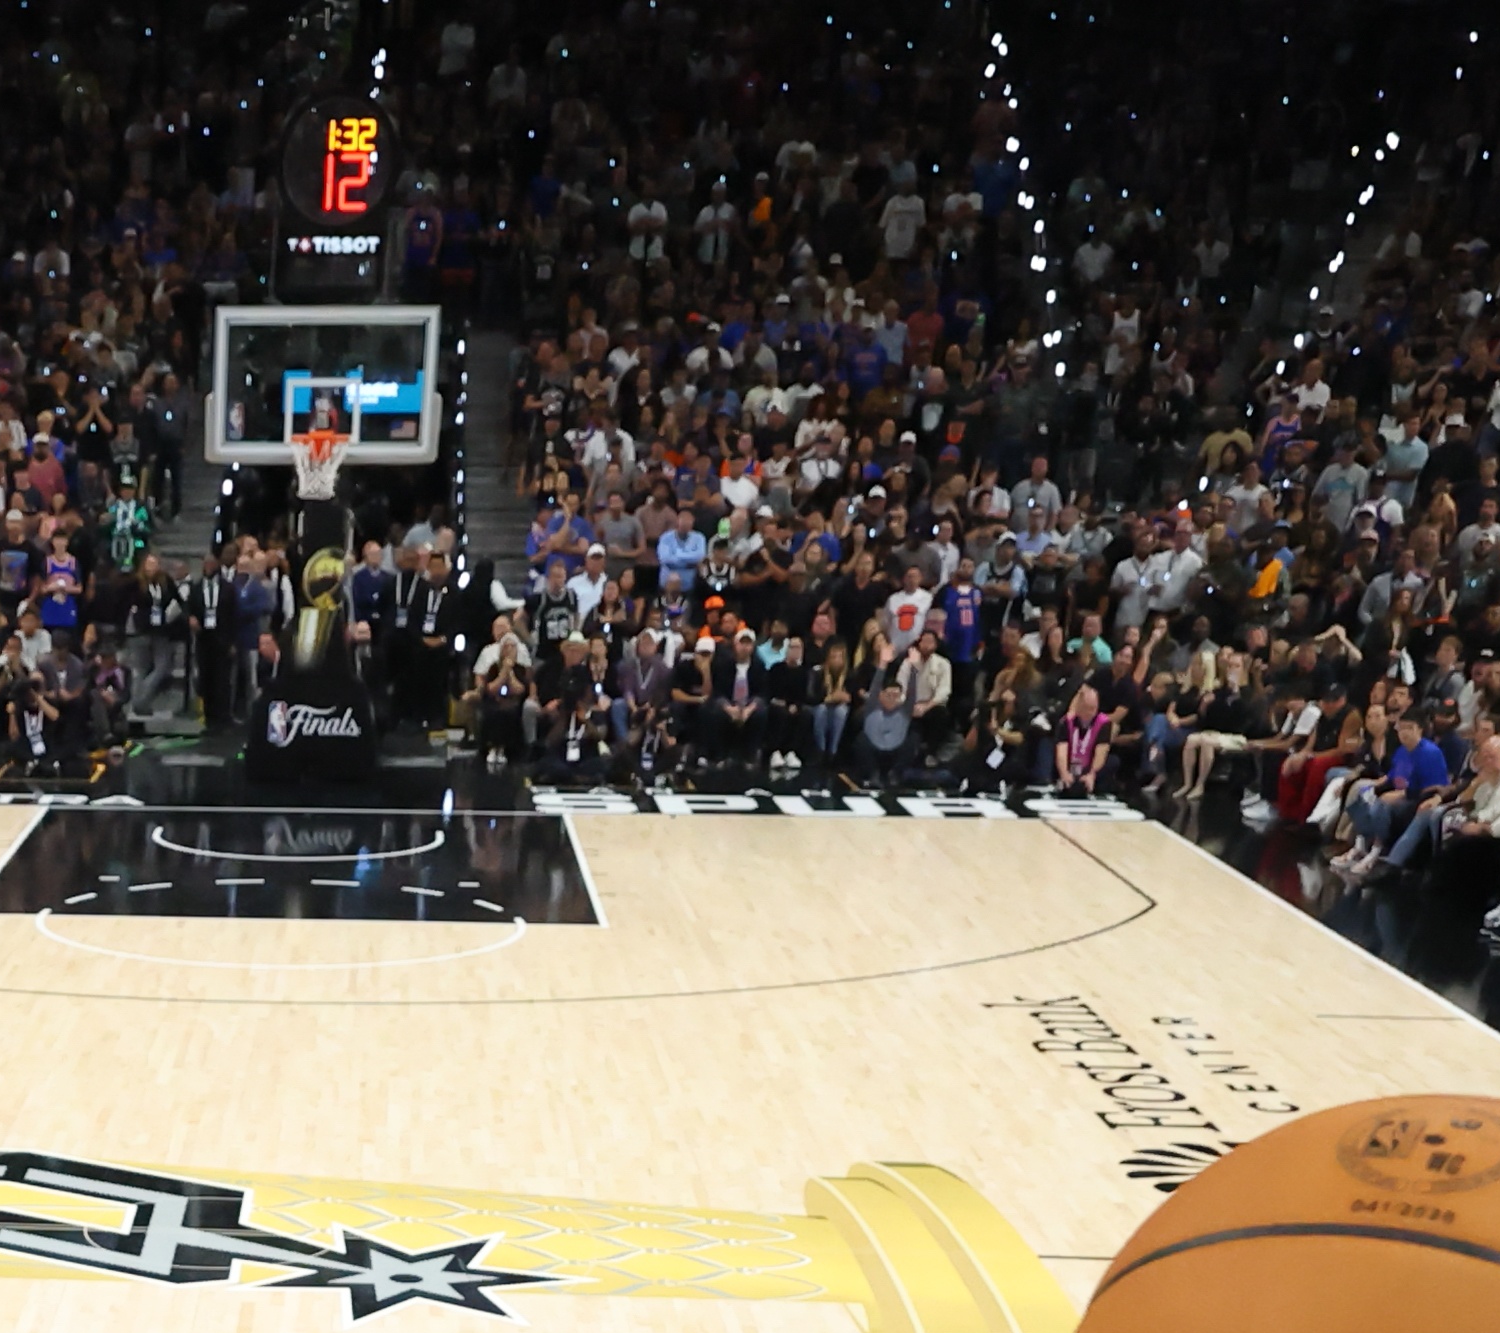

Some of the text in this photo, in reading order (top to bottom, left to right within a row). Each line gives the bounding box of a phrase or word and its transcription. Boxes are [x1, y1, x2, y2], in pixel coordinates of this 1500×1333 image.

[328, 117, 378, 151] 1:32
[322, 152, 372, 212] 12
[312, 236, 381, 254] TISSOT
[278, 703, 362, 748] Finals
[531, 794, 1147, 822] SPURS
[1150, 1016, 1301, 1115] CENTER
